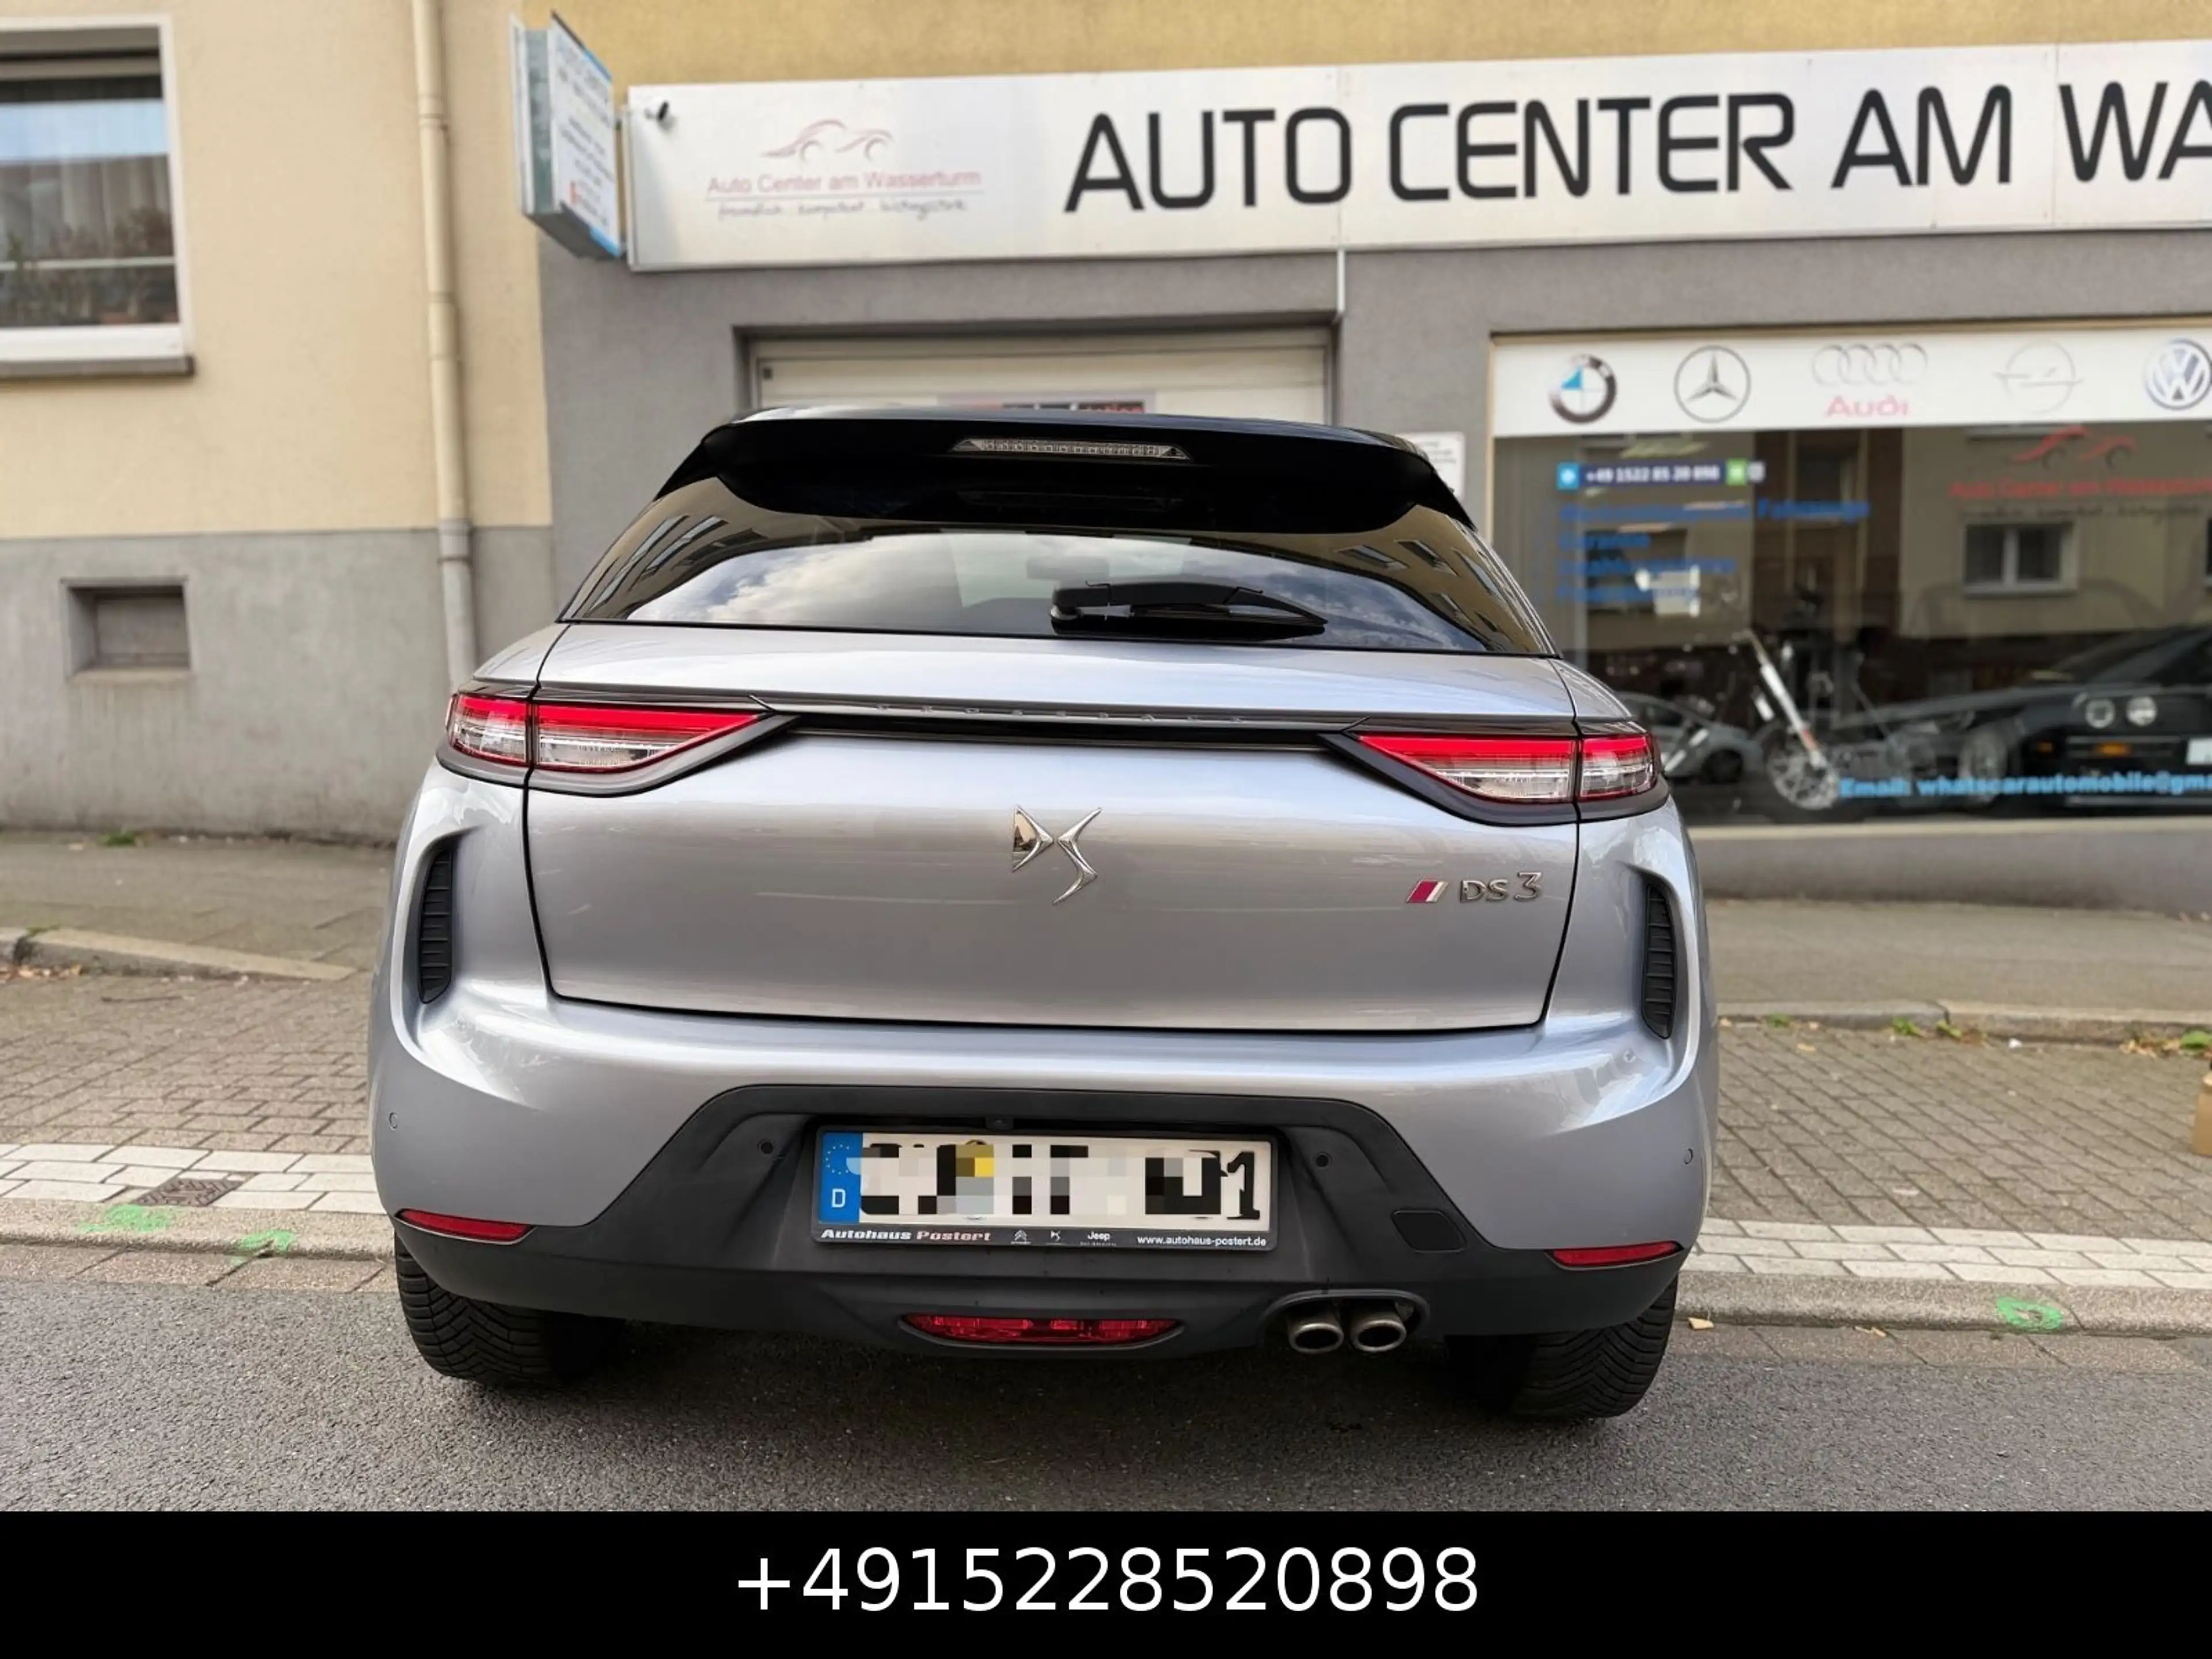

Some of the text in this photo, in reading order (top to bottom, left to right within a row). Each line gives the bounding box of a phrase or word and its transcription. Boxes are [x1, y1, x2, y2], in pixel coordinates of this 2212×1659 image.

[1065, 79, 2212, 213] AUTO CENTER AM WA
[1825, 394, 1909, 418] Audi
[831, 1188, 846, 1208] D
[821, 1229, 991, 1241] Autohaus Postert
[1087, 1231, 1111, 1241] Jeep
[1137, 1234, 1267, 1247] www.autohaus-postert.de
